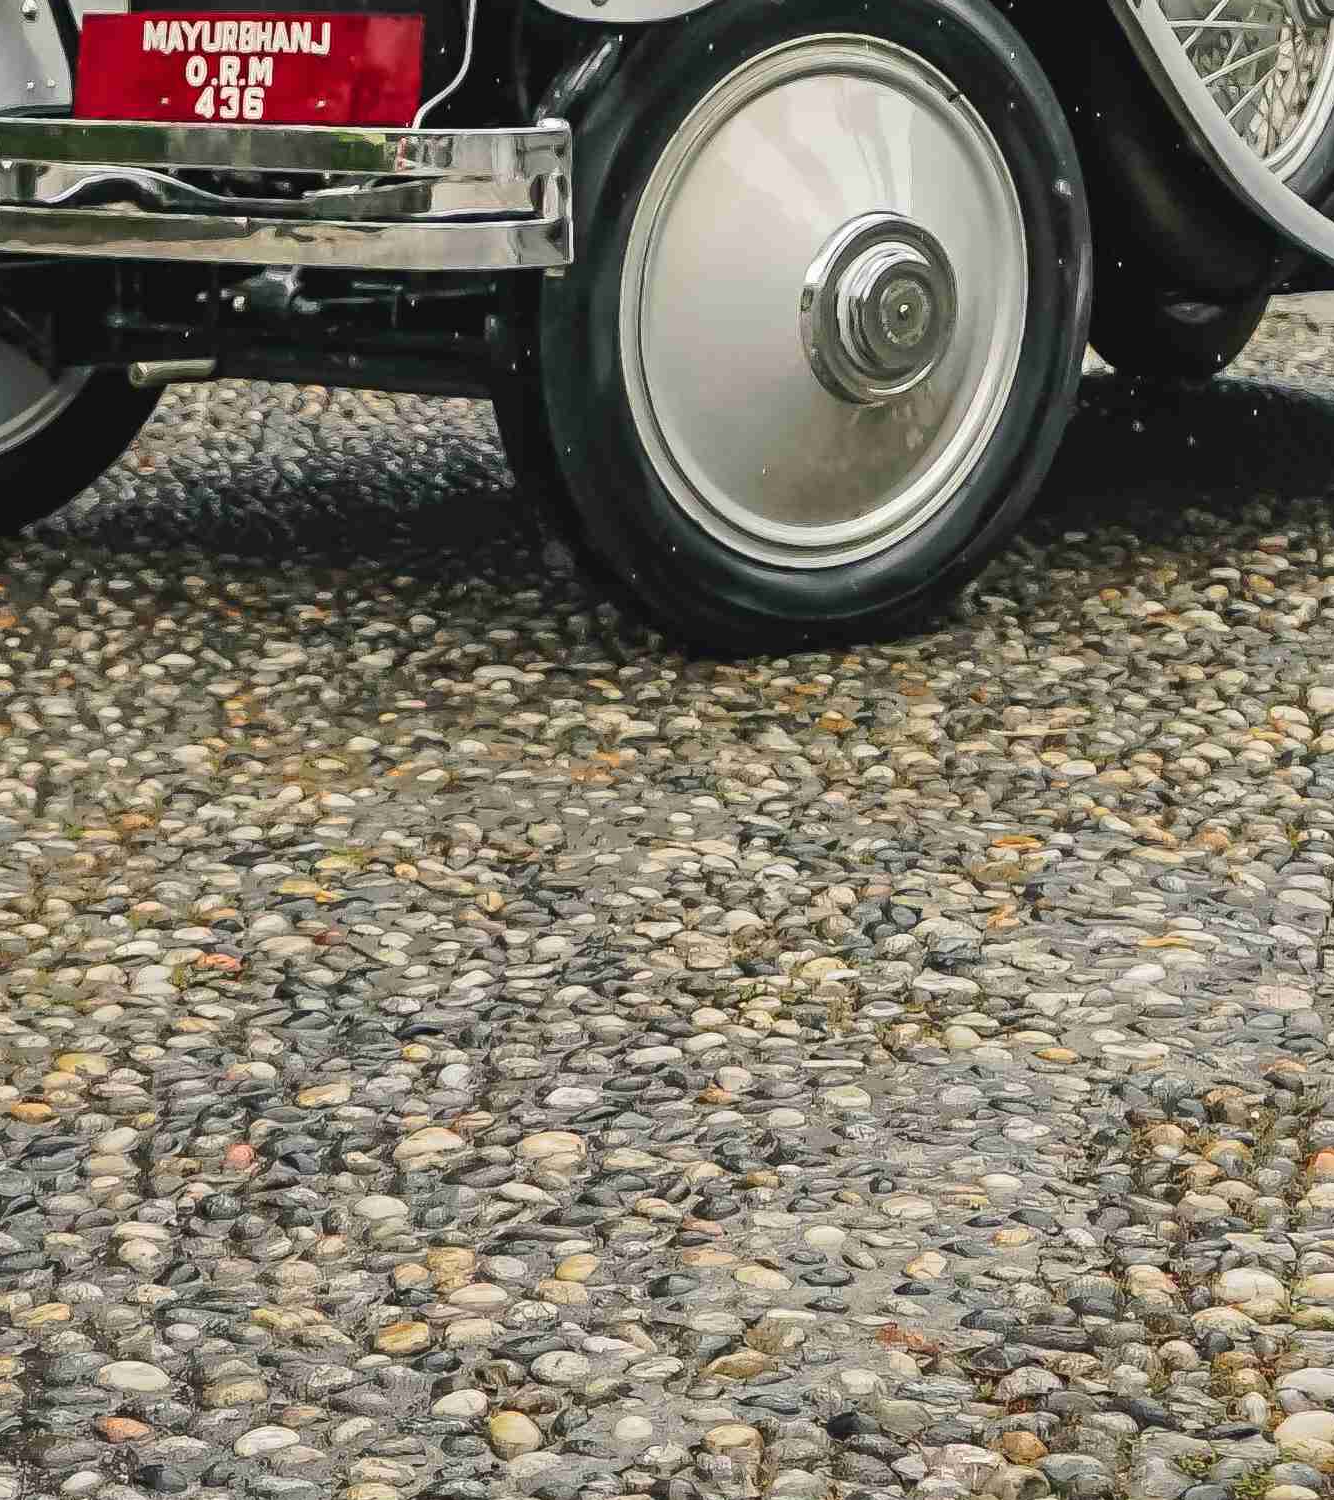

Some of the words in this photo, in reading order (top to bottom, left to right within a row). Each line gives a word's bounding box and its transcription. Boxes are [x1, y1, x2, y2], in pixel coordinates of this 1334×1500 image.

[142, 20, 331, 55] MAYURBHANJ
[185, 56, 274, 88] O.R.M
[194, 87, 265, 119] 436
